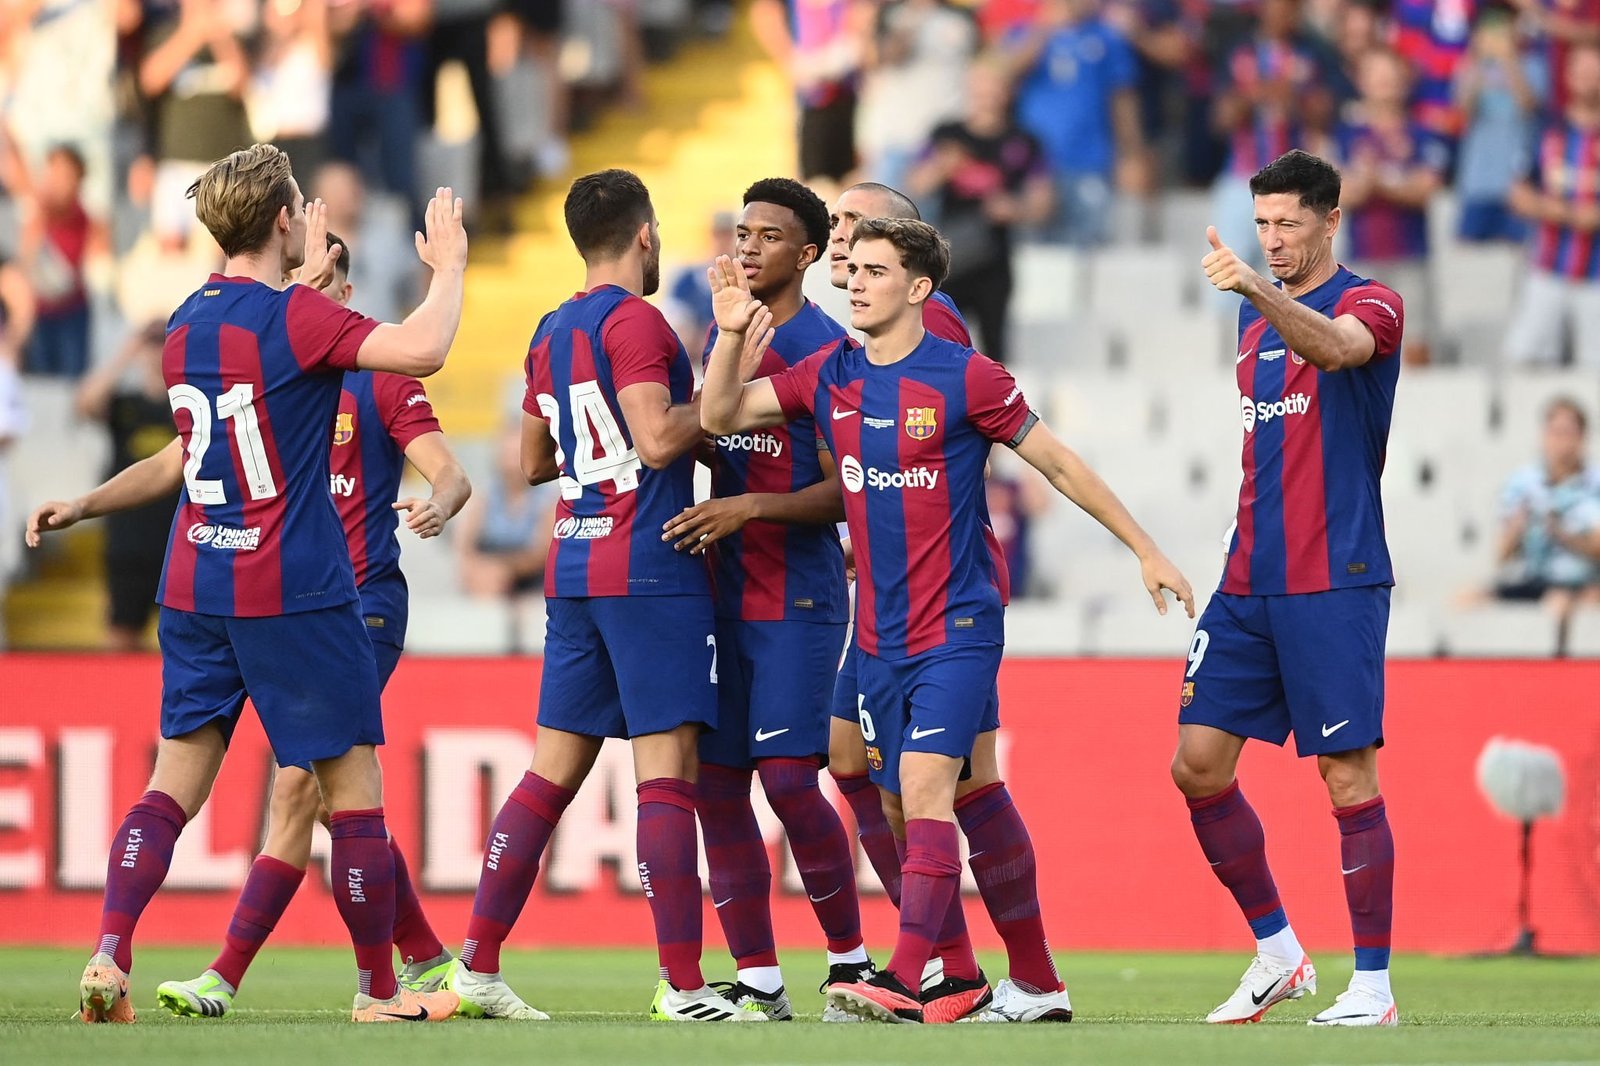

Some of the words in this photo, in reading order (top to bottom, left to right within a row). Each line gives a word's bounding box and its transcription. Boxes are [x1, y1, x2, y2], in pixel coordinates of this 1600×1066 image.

[1256, 392, 1312, 423] Spotify
[167, 383, 278, 505] 21
[535, 379, 643, 501] 24
[717, 432, 784, 458] Spotify
[866, 466, 940, 491] Spotify
[580, 516, 614, 528] UNHCR
[1186, 629, 1210, 678] 9
[857, 693, 876, 742] 6
[120, 828, 144, 868] BARÇA
[486, 831, 509, 871] BARÇA
[348, 867, 367, 903] BARÇA
[638, 861, 655, 898] BARÇA
